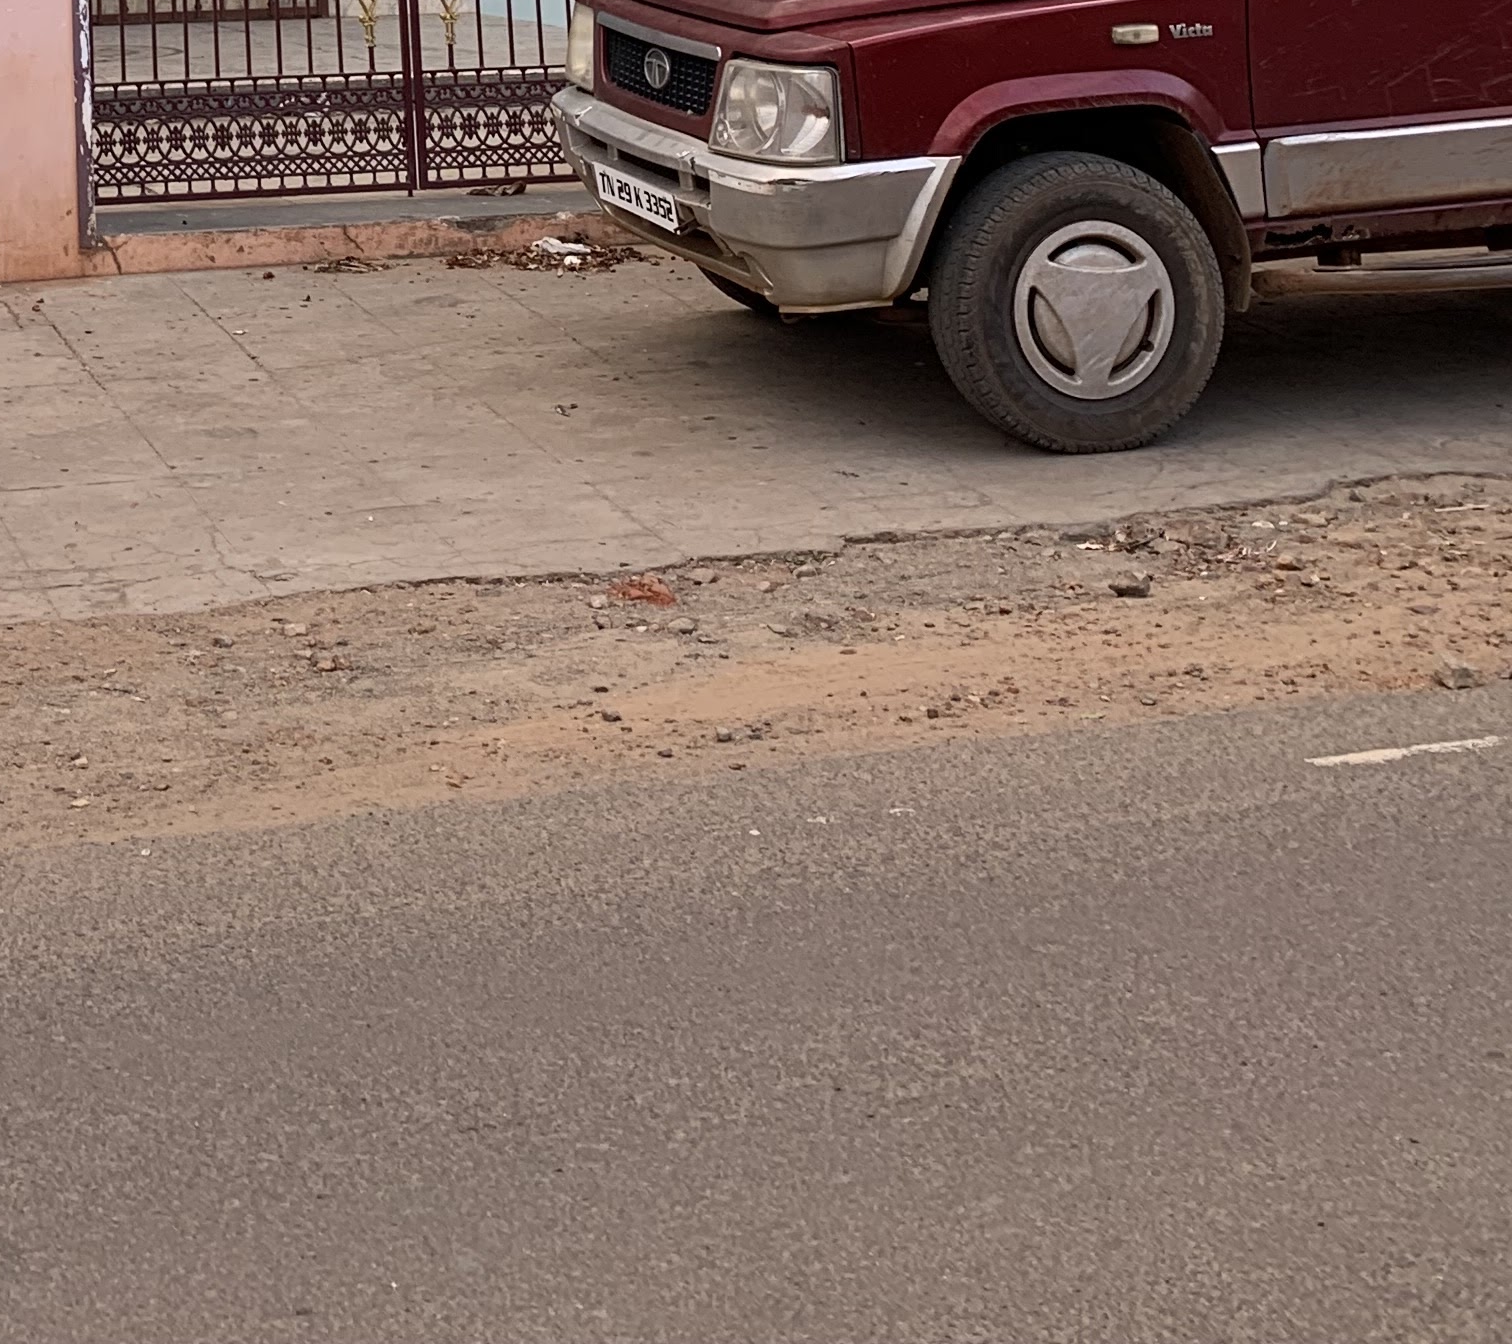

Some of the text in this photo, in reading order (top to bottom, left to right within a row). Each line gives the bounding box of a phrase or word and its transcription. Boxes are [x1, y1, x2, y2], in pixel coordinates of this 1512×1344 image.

[599, 171, 675, 223] TN 29 K 3352
